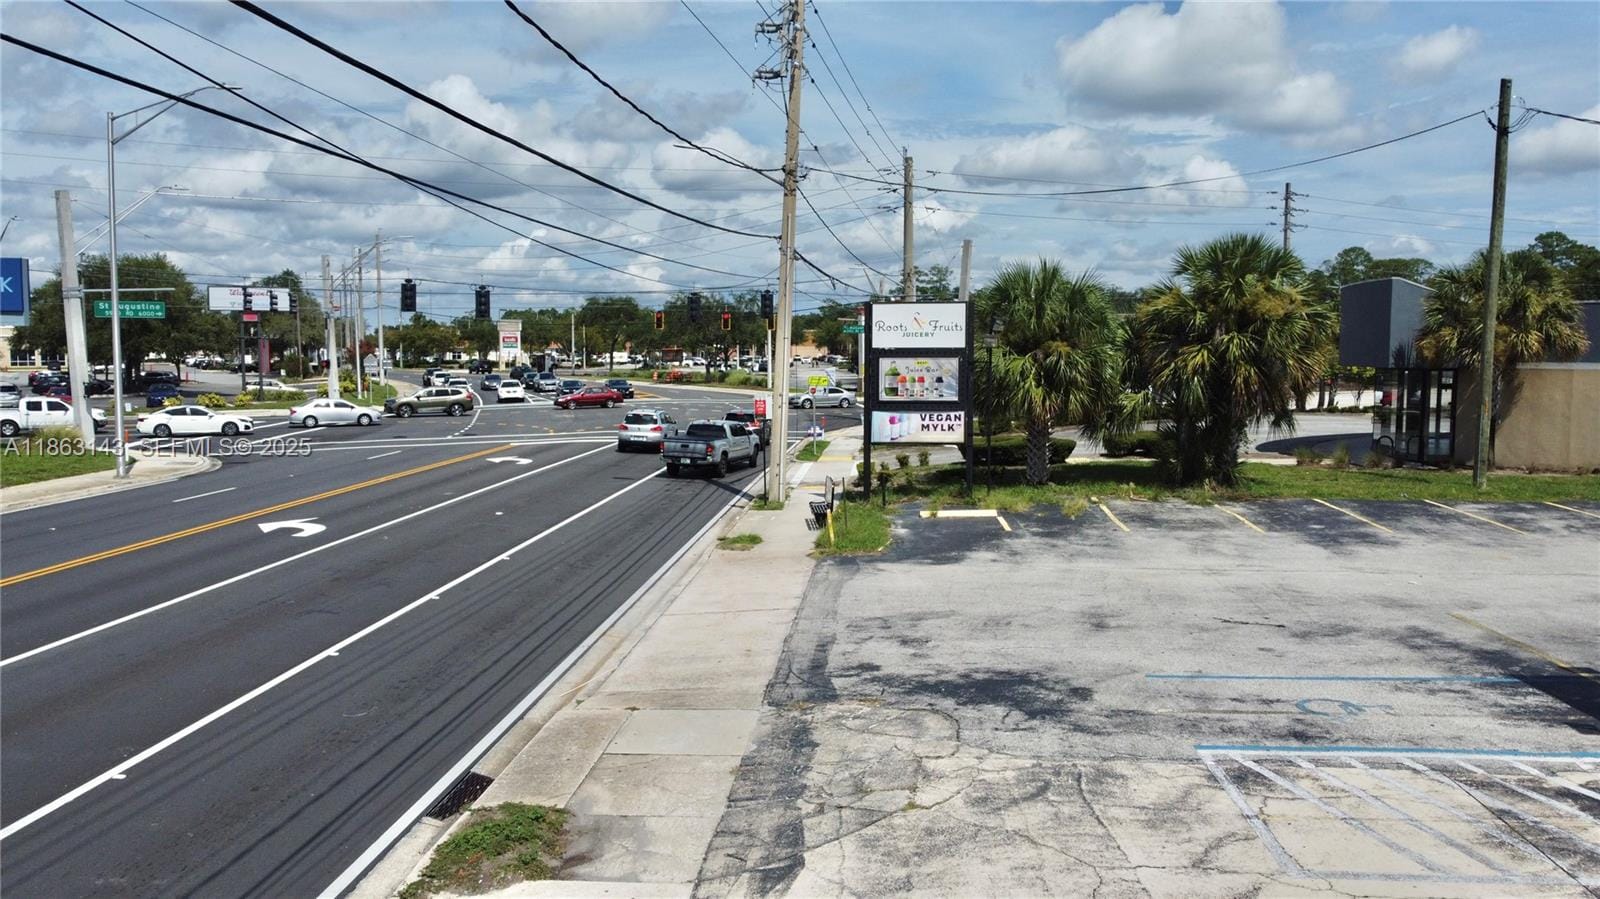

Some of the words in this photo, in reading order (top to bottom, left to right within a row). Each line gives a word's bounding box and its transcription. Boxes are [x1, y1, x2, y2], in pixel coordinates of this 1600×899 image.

[98, 302, 109, 310] St
[112, 303, 160, 312] ugustine
[874, 320, 908, 332] Roots
[928, 320, 963, 332] Fruits
[919, 413, 962, 422] VEGAN
